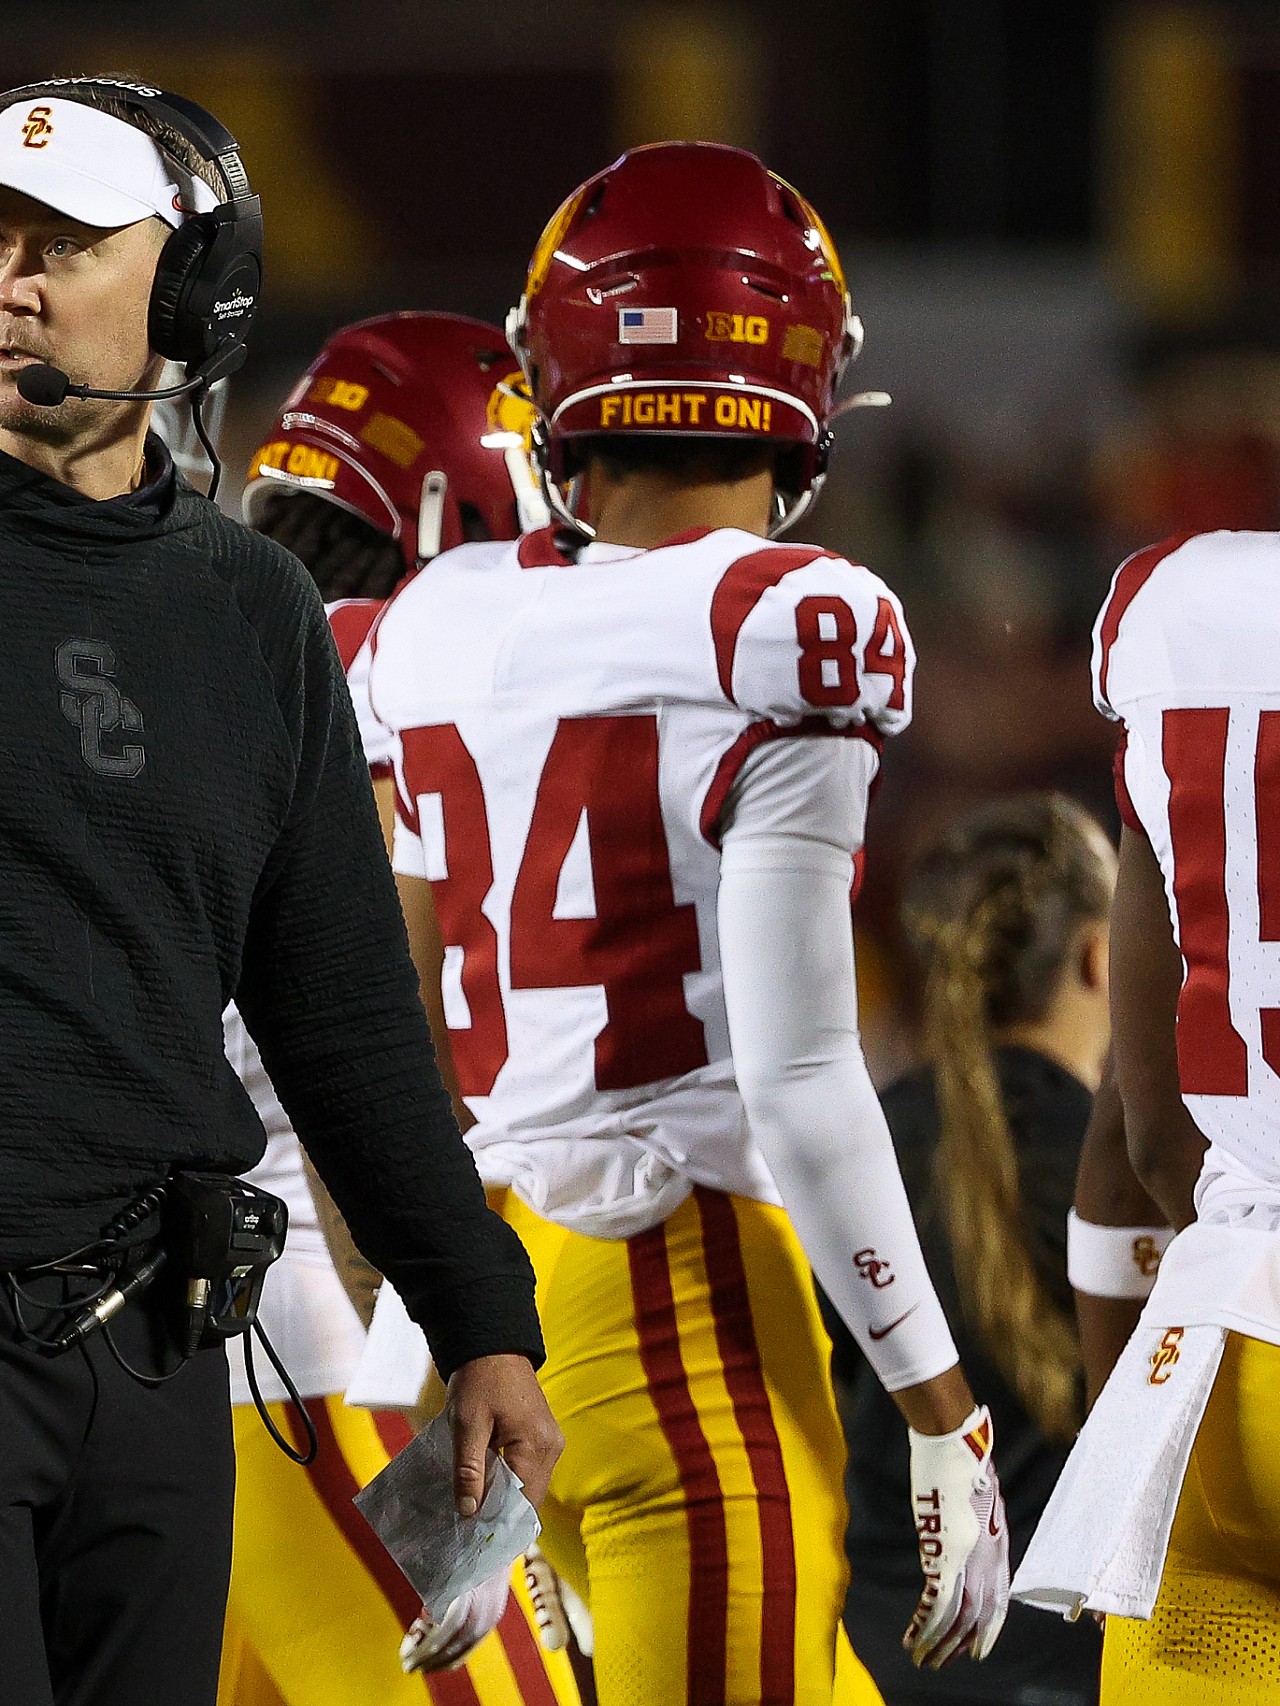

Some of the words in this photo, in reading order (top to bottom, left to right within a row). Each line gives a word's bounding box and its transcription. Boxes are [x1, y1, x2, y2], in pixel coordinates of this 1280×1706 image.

[213, 295, 254, 313] SmartStop
[600, 393, 707, 427] FIGHT
[714, 395, 771, 431] ON!
[794, 595, 906, 711] 84
[54, 634, 146, 779] SC
[399, 714, 709, 1096] 84
[852, 1247, 896, 1289] SC
